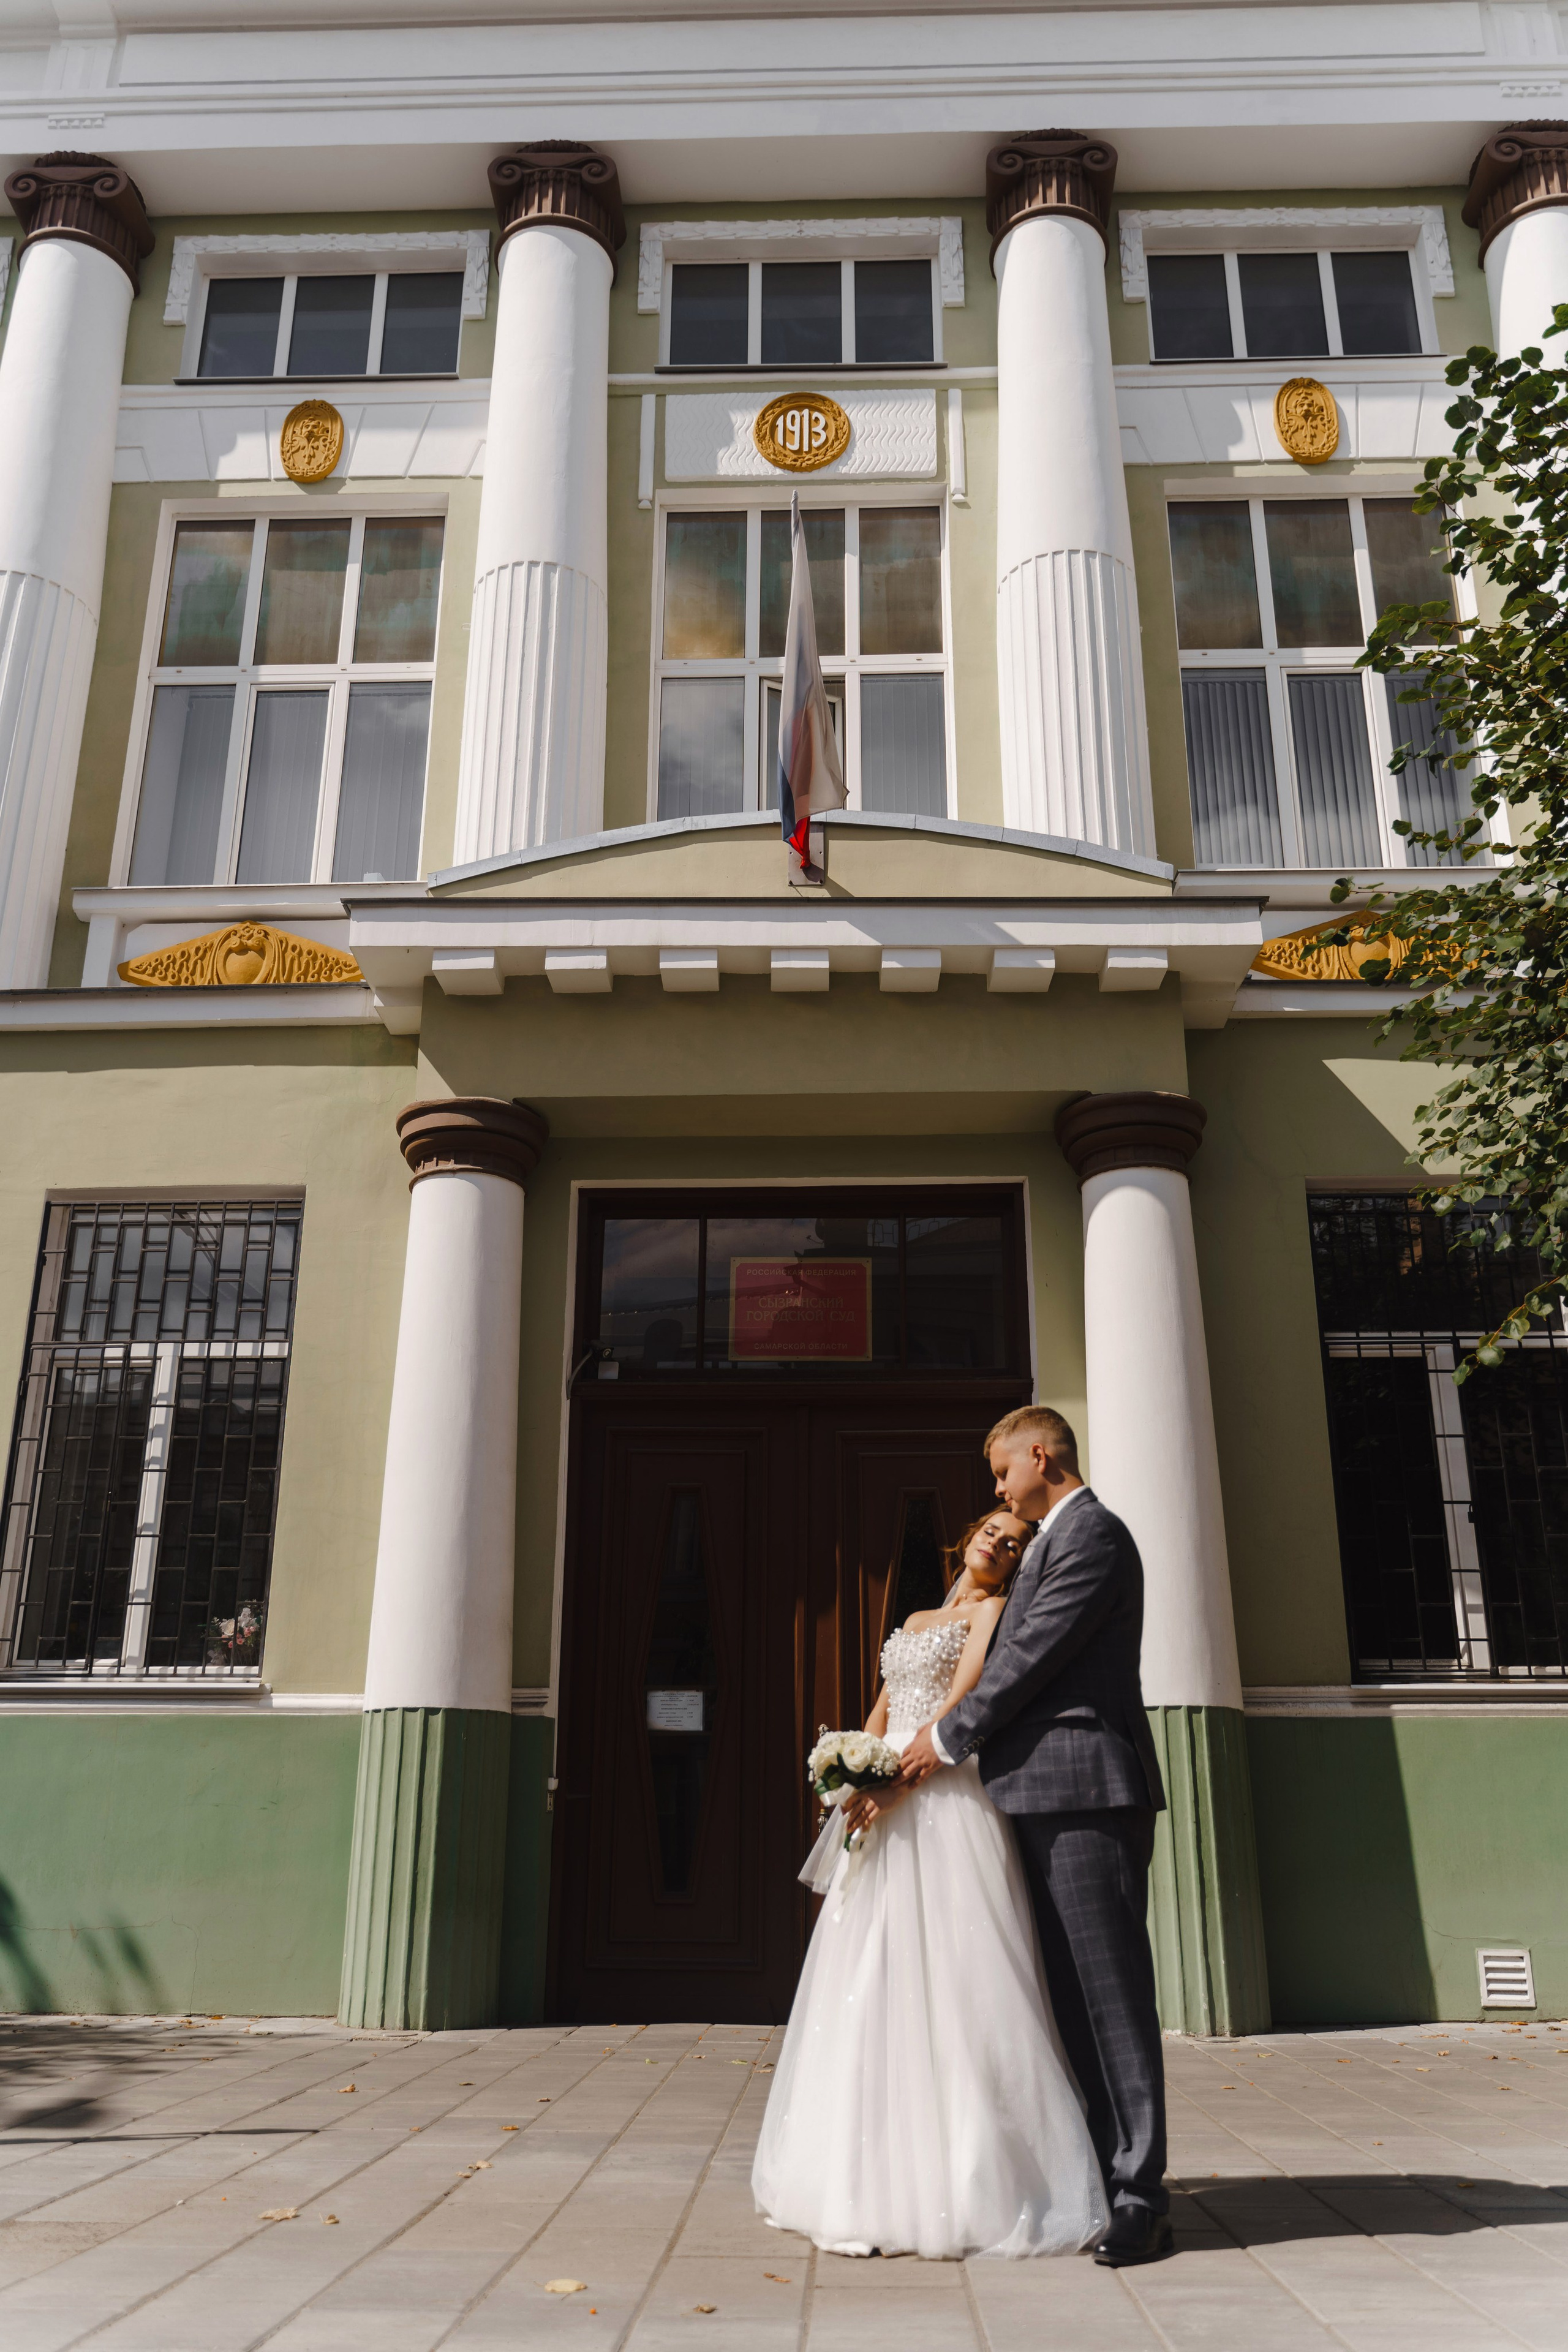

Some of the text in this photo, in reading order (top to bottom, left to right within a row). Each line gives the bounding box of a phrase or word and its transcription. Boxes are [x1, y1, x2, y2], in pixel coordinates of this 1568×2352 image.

[776, 409, 826, 452] 1913
[758, 1297, 844, 1308] СЫЗРАНСКИЙ
[746, 1310, 856, 1322] ГОРОДСКОЙ СУД
